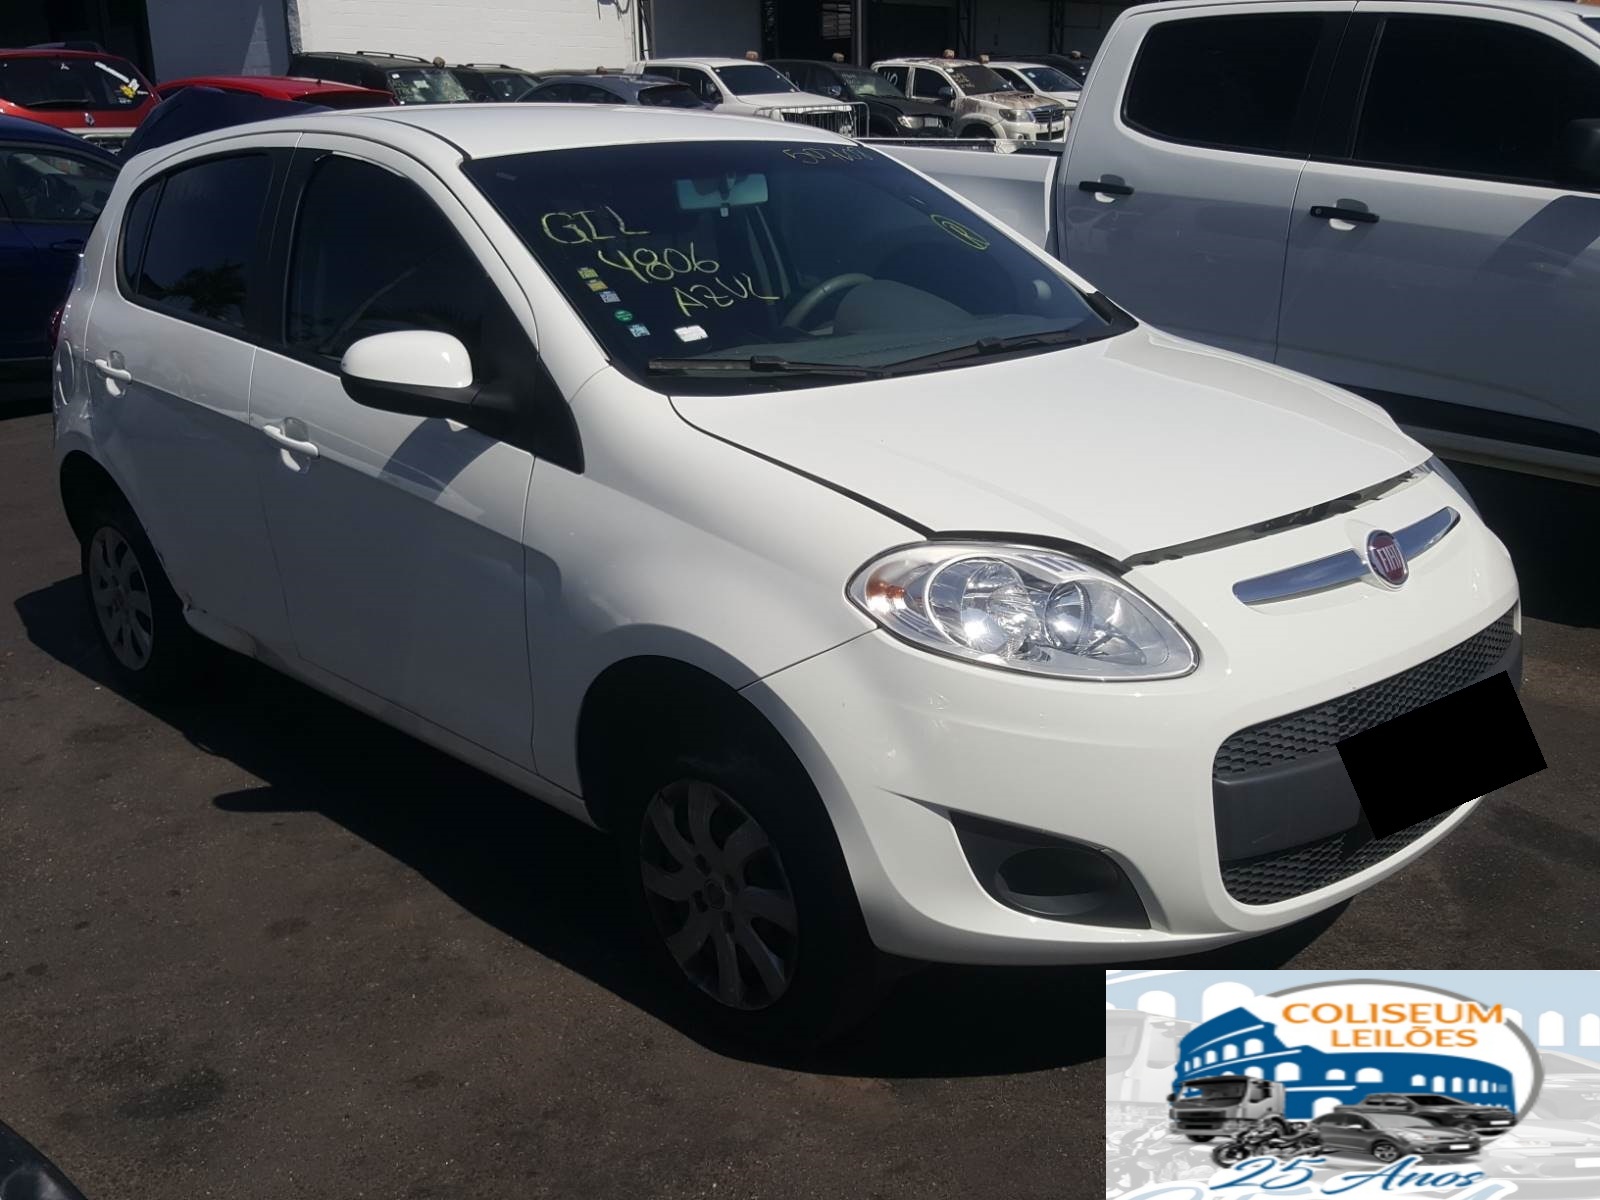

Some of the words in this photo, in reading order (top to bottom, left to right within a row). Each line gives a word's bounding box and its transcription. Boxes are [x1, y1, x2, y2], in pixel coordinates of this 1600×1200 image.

[541, 206, 650, 243] GIL
[598, 241, 719, 283] 4806
[673, 272, 780, 317] AZUL
[1376, 544, 1403, 572] FIAT
